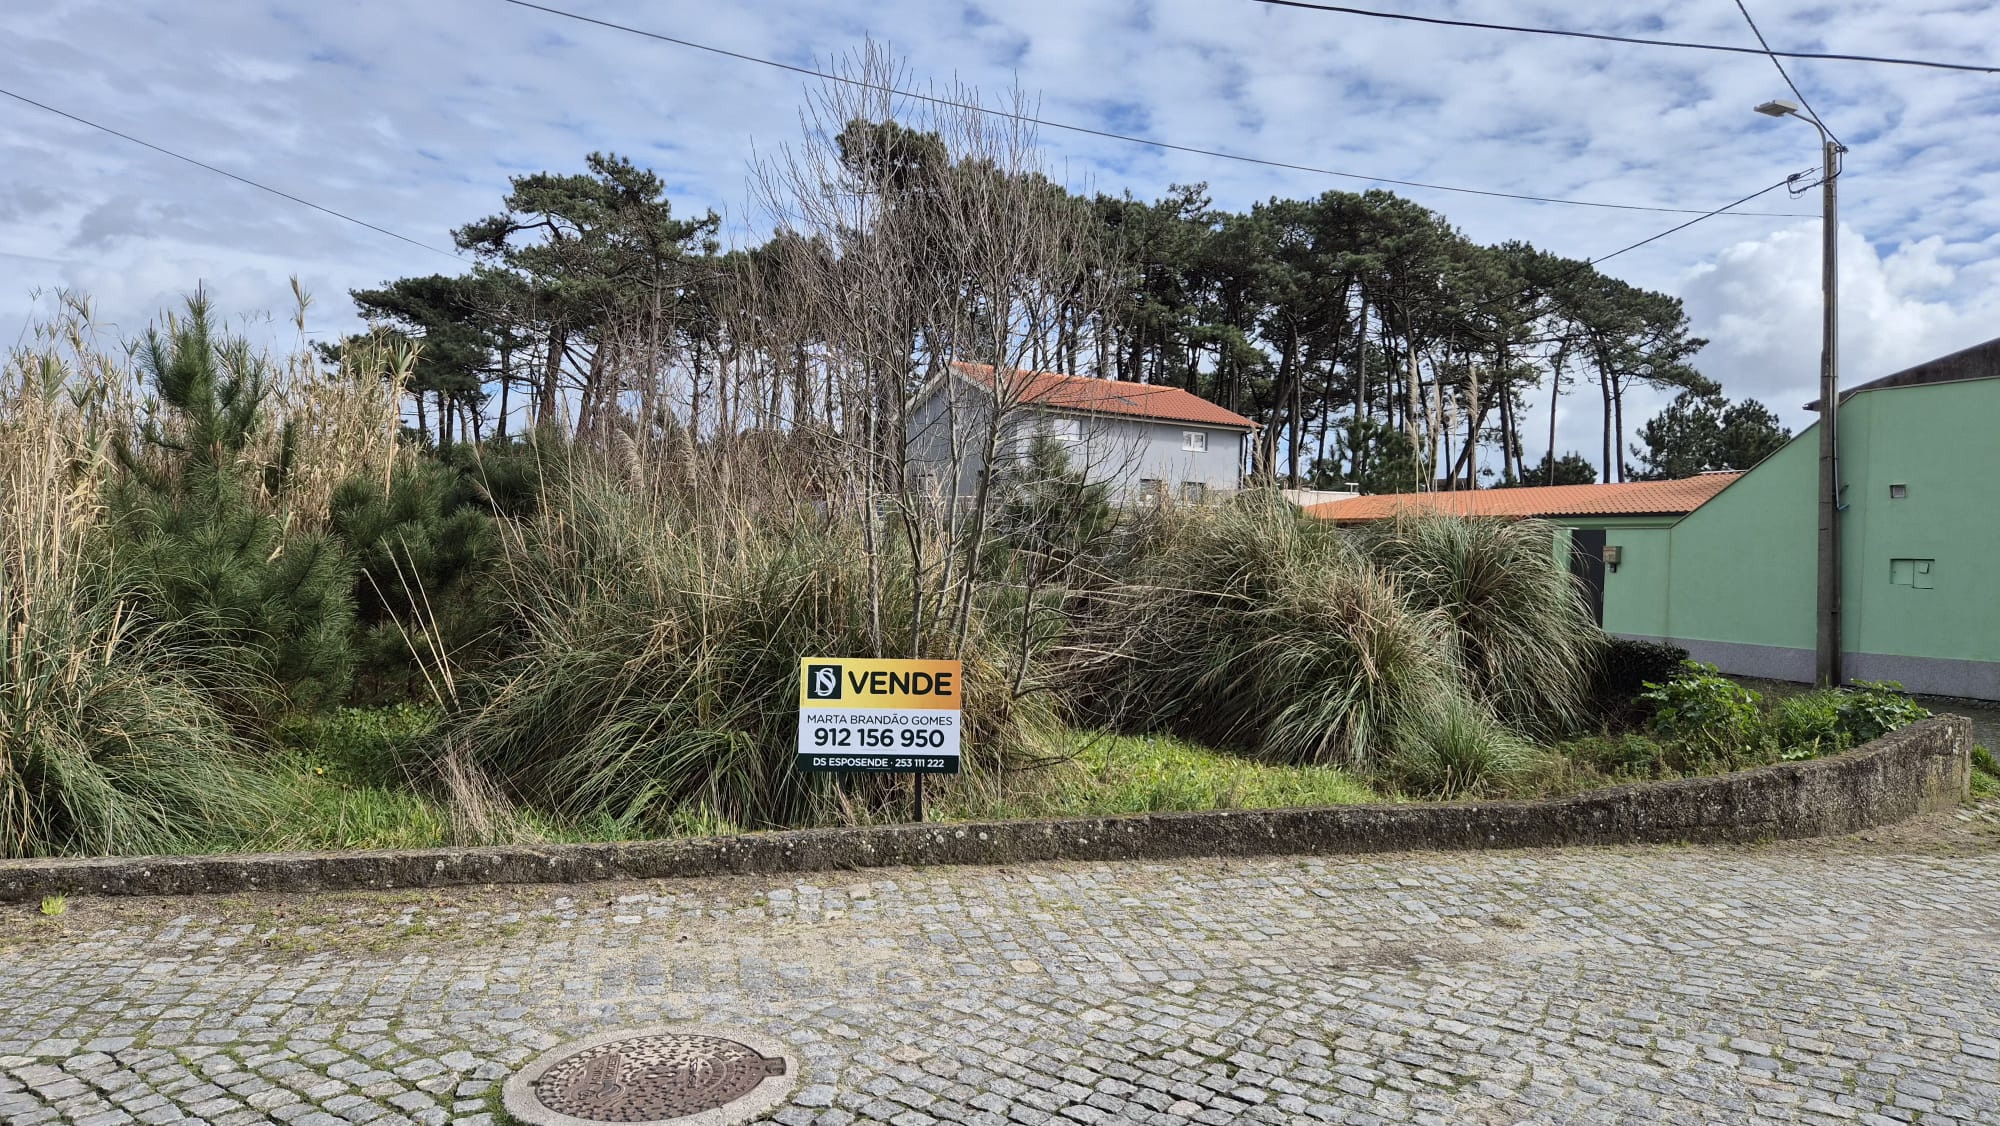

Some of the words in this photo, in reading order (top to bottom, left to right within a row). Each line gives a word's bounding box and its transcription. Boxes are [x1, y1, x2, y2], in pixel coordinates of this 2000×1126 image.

[848, 670, 953, 696] VENDE
[807, 714, 848, 725] MARTA
[850, 713, 908, 725] BRANDÃO
[911, 716, 953, 726] GOMES
[814, 727, 851, 747] 912
[857, 728, 894, 748] 156
[900, 729, 945, 748] 950
[813, 757, 827, 766] DS
[829, 757, 888, 767] ESPOSENDE
[894, 758, 913, 768] 253
[915, 758, 925, 768] 111
[927, 759, 945, 768] 222
